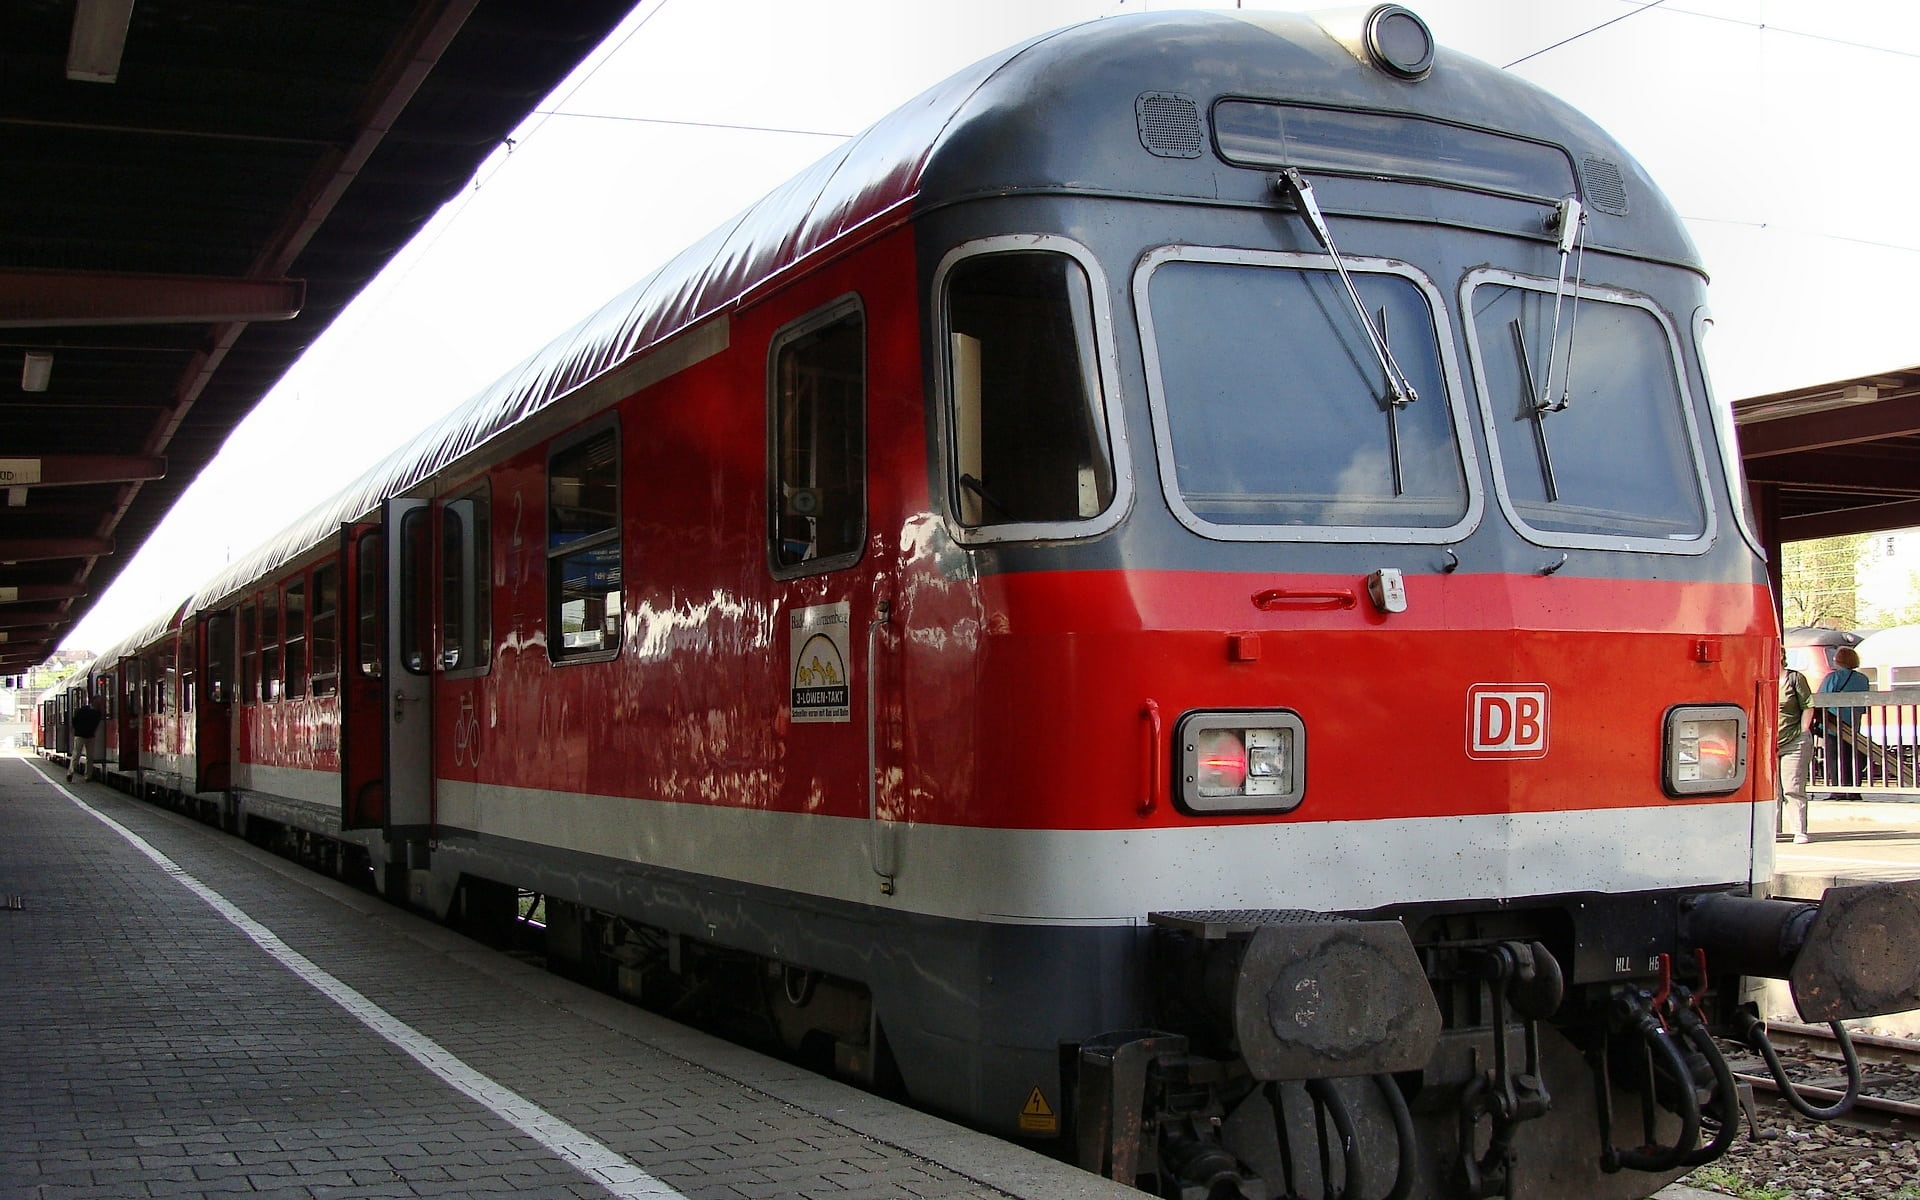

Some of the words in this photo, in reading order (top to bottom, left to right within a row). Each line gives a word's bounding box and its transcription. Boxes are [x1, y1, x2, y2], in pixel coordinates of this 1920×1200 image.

[513, 490, 522, 545] 2
[1479, 696, 1540, 746] DB
[1615, 956, 1631, 973] HLL
